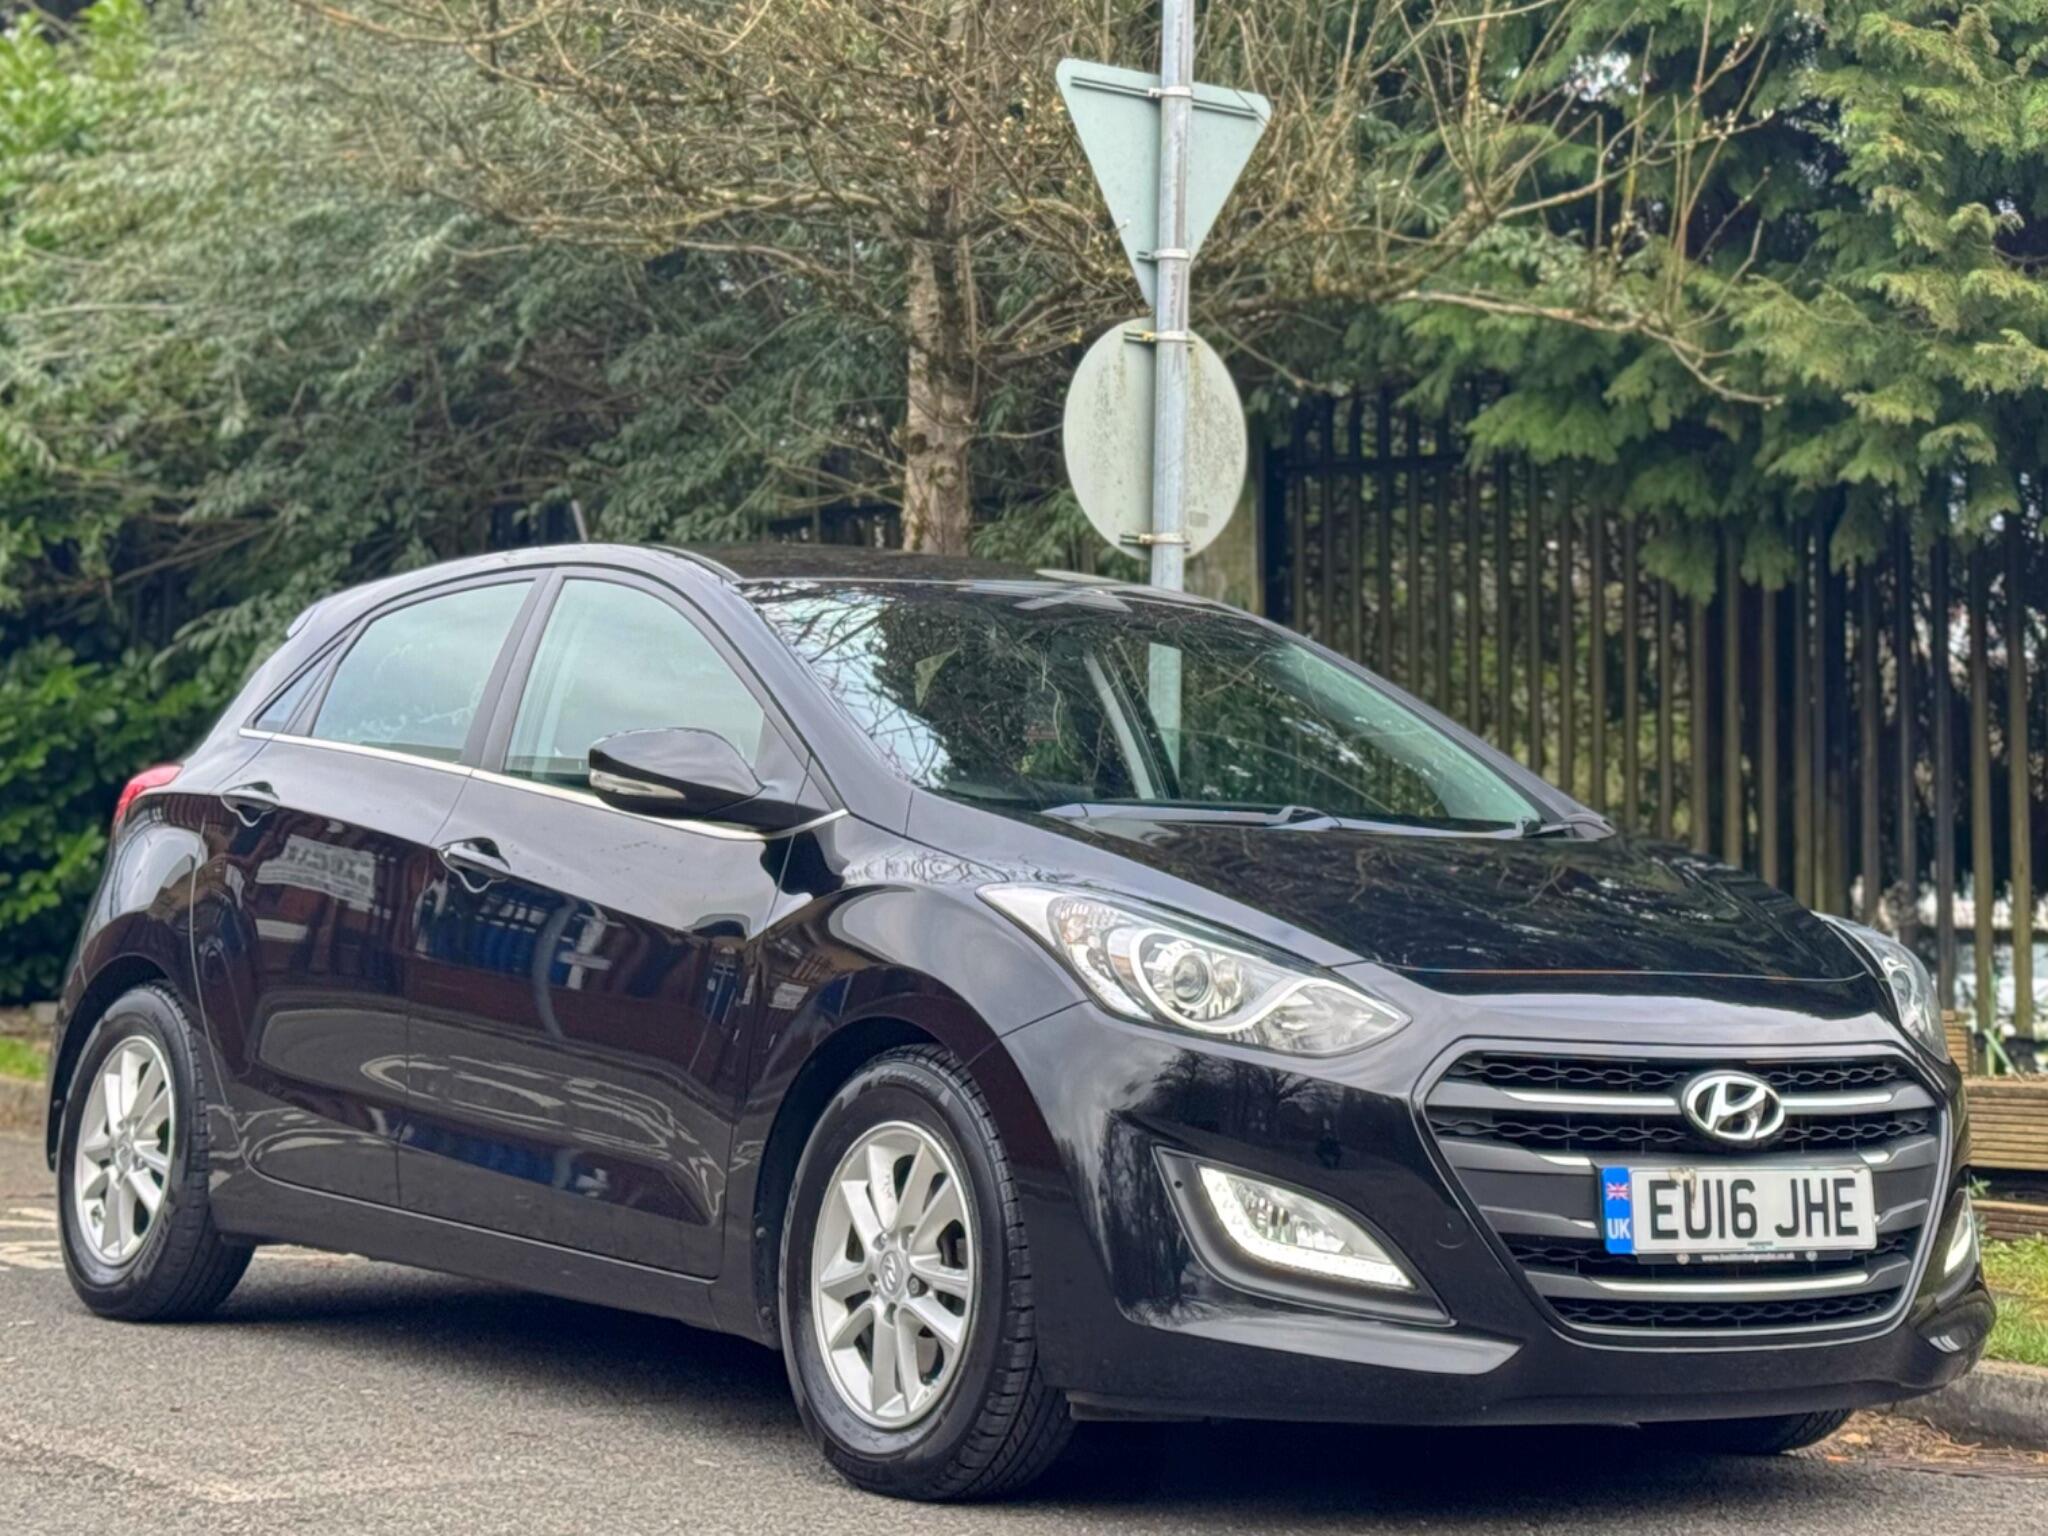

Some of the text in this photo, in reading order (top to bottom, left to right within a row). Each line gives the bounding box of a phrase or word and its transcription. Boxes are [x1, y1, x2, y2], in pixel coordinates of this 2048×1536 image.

[1607, 1217, 1631, 1240] UK
[1648, 1178, 1859, 1240] EU16 JHE
